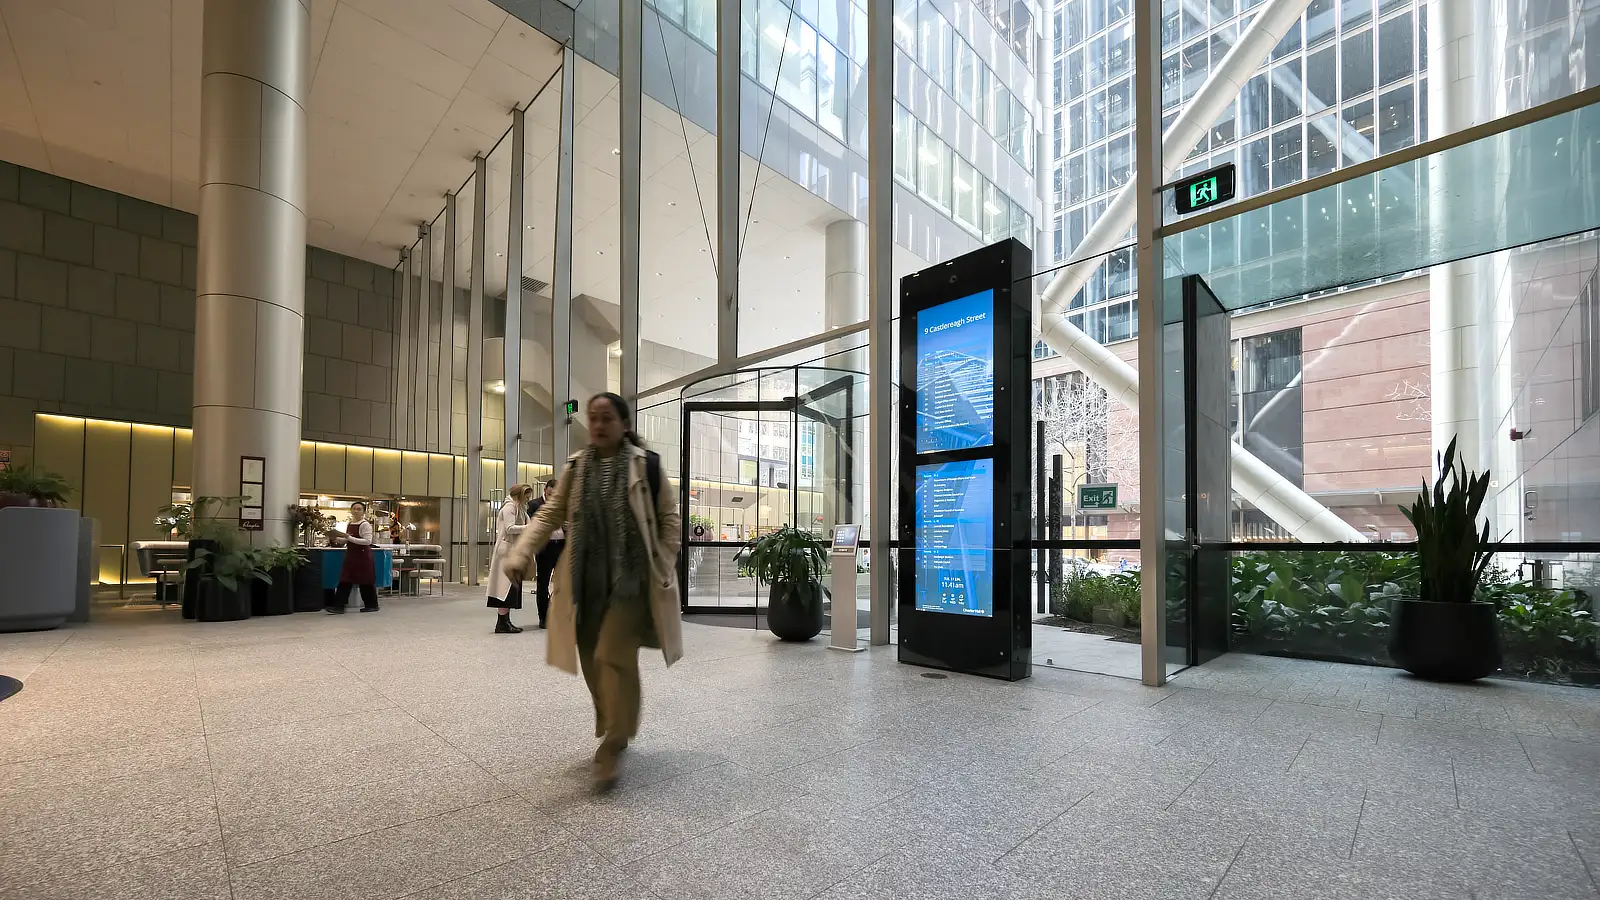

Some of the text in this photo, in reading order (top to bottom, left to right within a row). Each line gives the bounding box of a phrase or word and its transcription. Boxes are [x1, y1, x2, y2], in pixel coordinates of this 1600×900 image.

[929, 318, 965, 333] Castlereagh
[966, 312, 986, 323] Street
[1083, 494, 1100, 502] Exit
